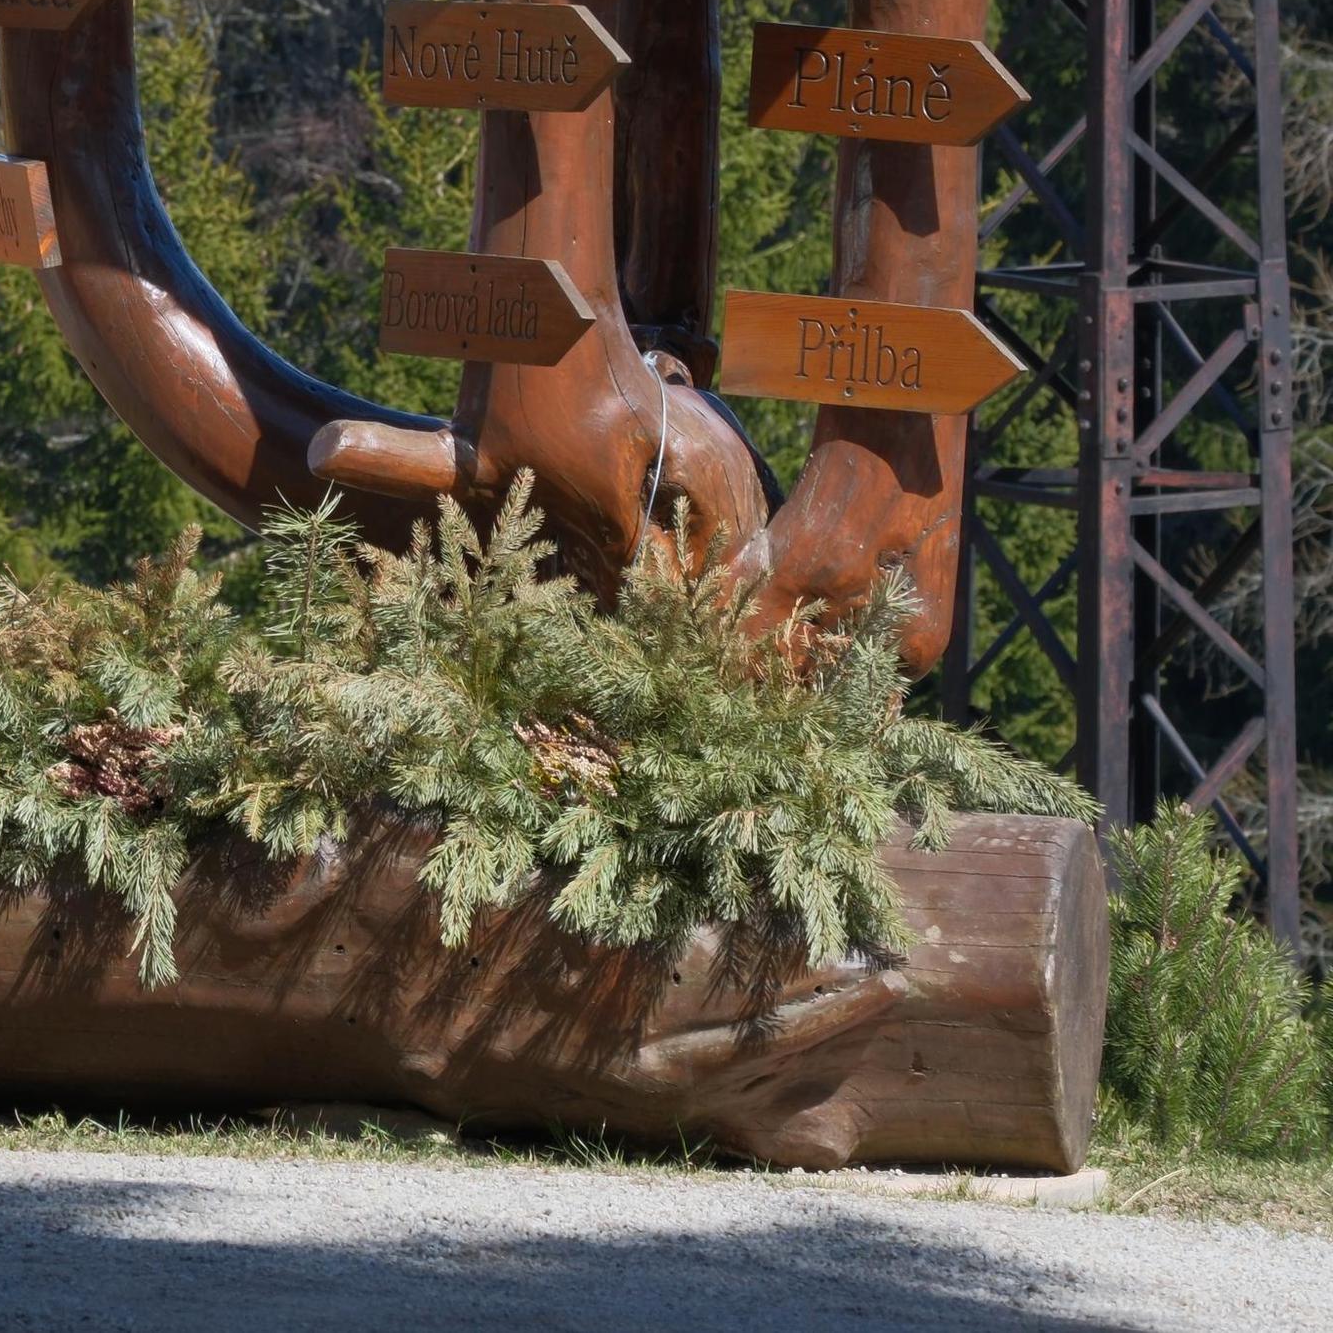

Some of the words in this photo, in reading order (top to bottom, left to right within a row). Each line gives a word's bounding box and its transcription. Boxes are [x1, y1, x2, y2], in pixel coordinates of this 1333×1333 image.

[388, 25, 481, 81] Nové
[495, 28, 578, 85] Hutě
[788, 48, 953, 123] Pláně
[385, 271, 479, 335] Borová
[486, 281, 538, 339] lada
[795, 318, 923, 391] Přilba
